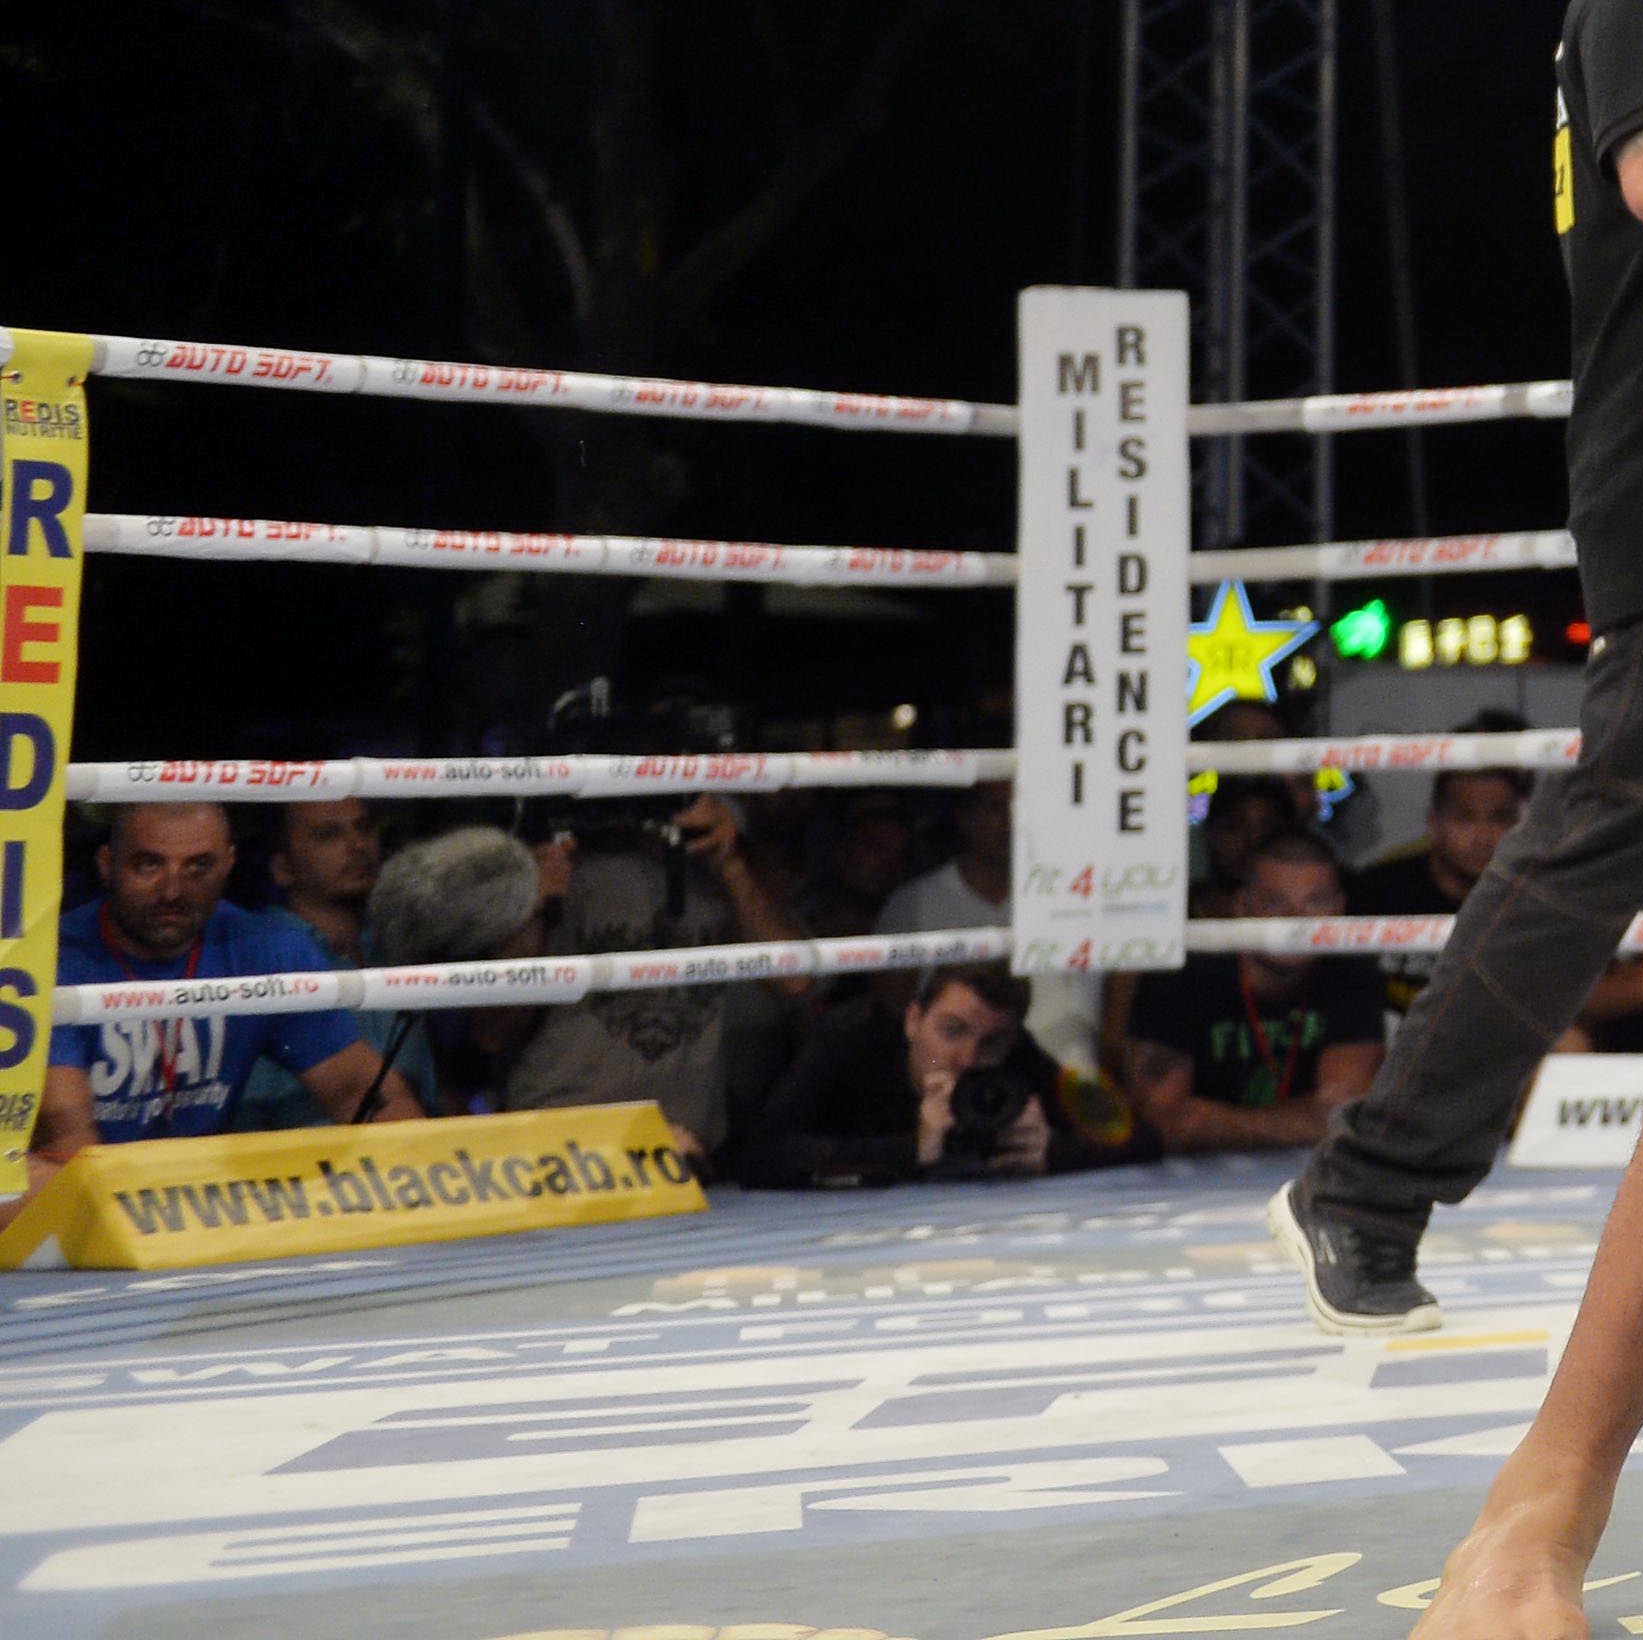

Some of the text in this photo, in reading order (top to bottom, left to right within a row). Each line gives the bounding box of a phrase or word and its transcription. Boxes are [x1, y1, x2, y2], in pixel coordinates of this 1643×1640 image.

[1056, 353, 1102, 805] MILITARI
[1115, 324, 1149, 834] RESIDENCE
[1068, 862, 1095, 900] 4
[112, 1139, 690, 1237] www.blackcab.ro
